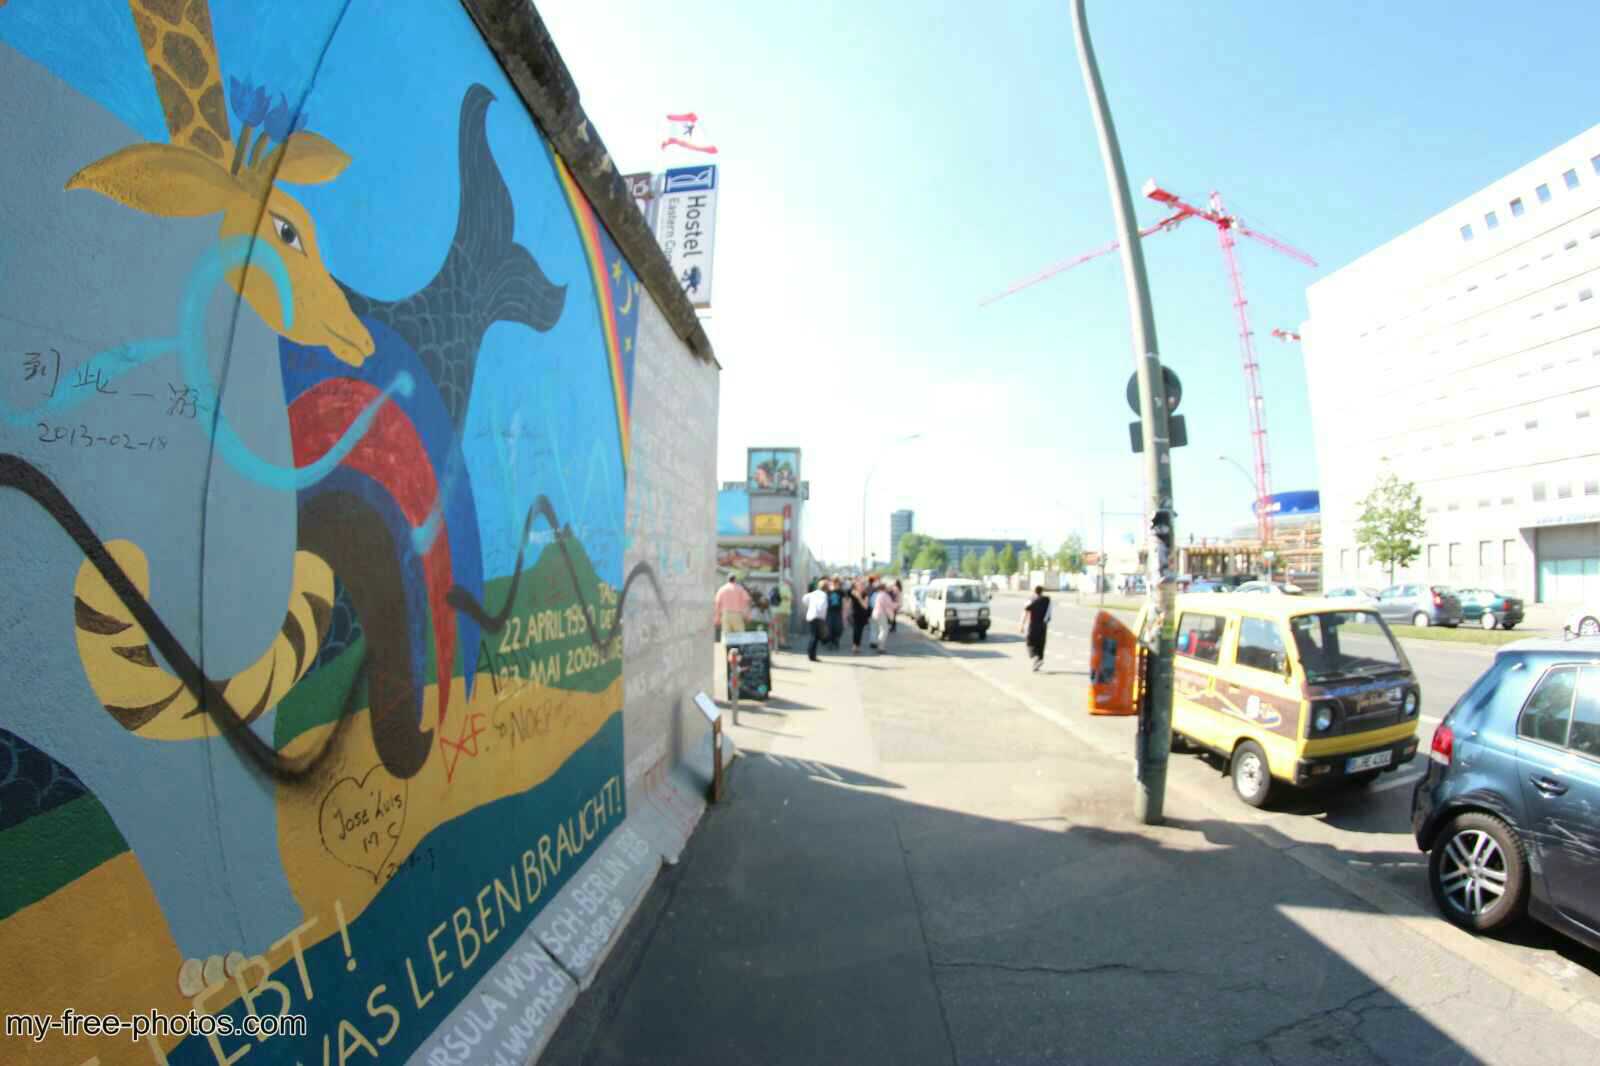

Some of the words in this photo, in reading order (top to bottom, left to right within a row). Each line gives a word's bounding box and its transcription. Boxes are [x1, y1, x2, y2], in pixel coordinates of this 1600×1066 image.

[684, 195, 706, 257] Hostel
[498, 615, 521, 653] 22
[525, 608, 566, 649] APRIL
[527, 652, 561, 688] MAI
[405, 865, 523, 1009] LEBEN
[521, 775, 624, 905] BRAUCHT!
